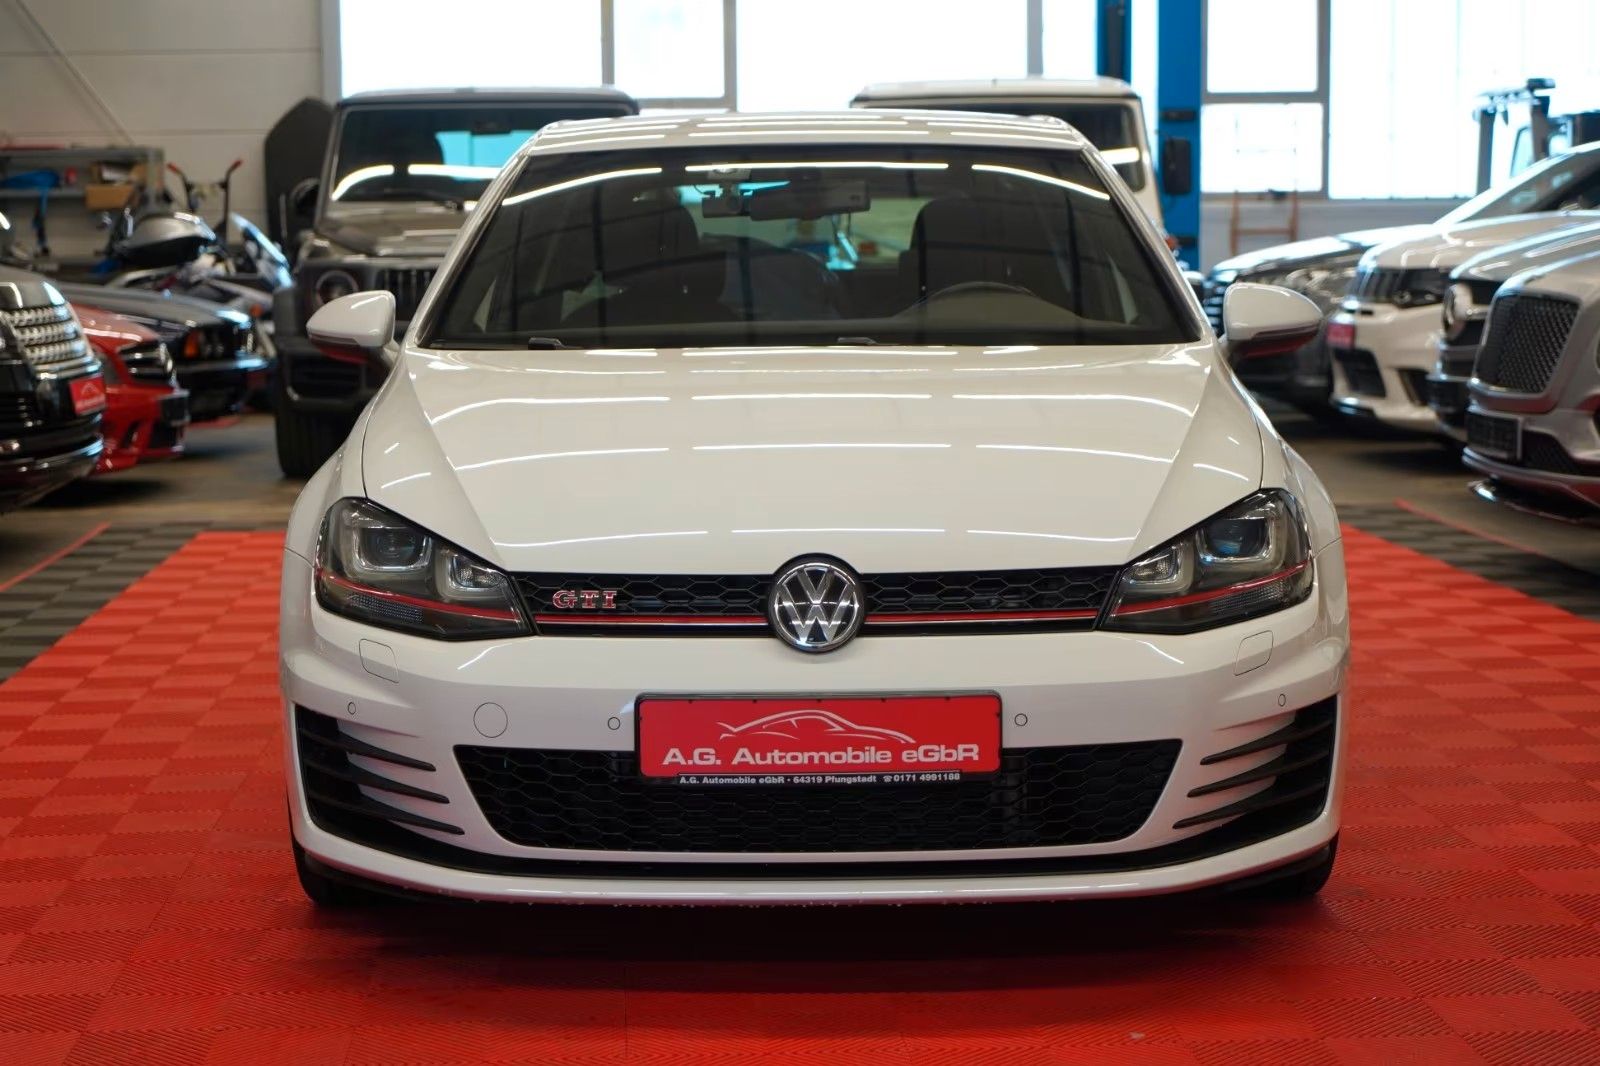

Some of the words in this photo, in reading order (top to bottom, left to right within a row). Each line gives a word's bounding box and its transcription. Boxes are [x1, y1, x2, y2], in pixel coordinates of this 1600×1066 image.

[552, 589, 618, 610] GTI
[662, 747, 722, 766] A.G.
[731, 746, 892, 765] Automobile
[901, 743, 979, 762] eGbR
[679, 776, 700, 785] A.G.
[702, 776, 757, 785] Automobile
[759, 776, 785, 785] eGbR
[793, 776, 823, 785] 64319
[825, 775, 877, 785] Pfungstadt
[893, 774, 917, 783] 0171
